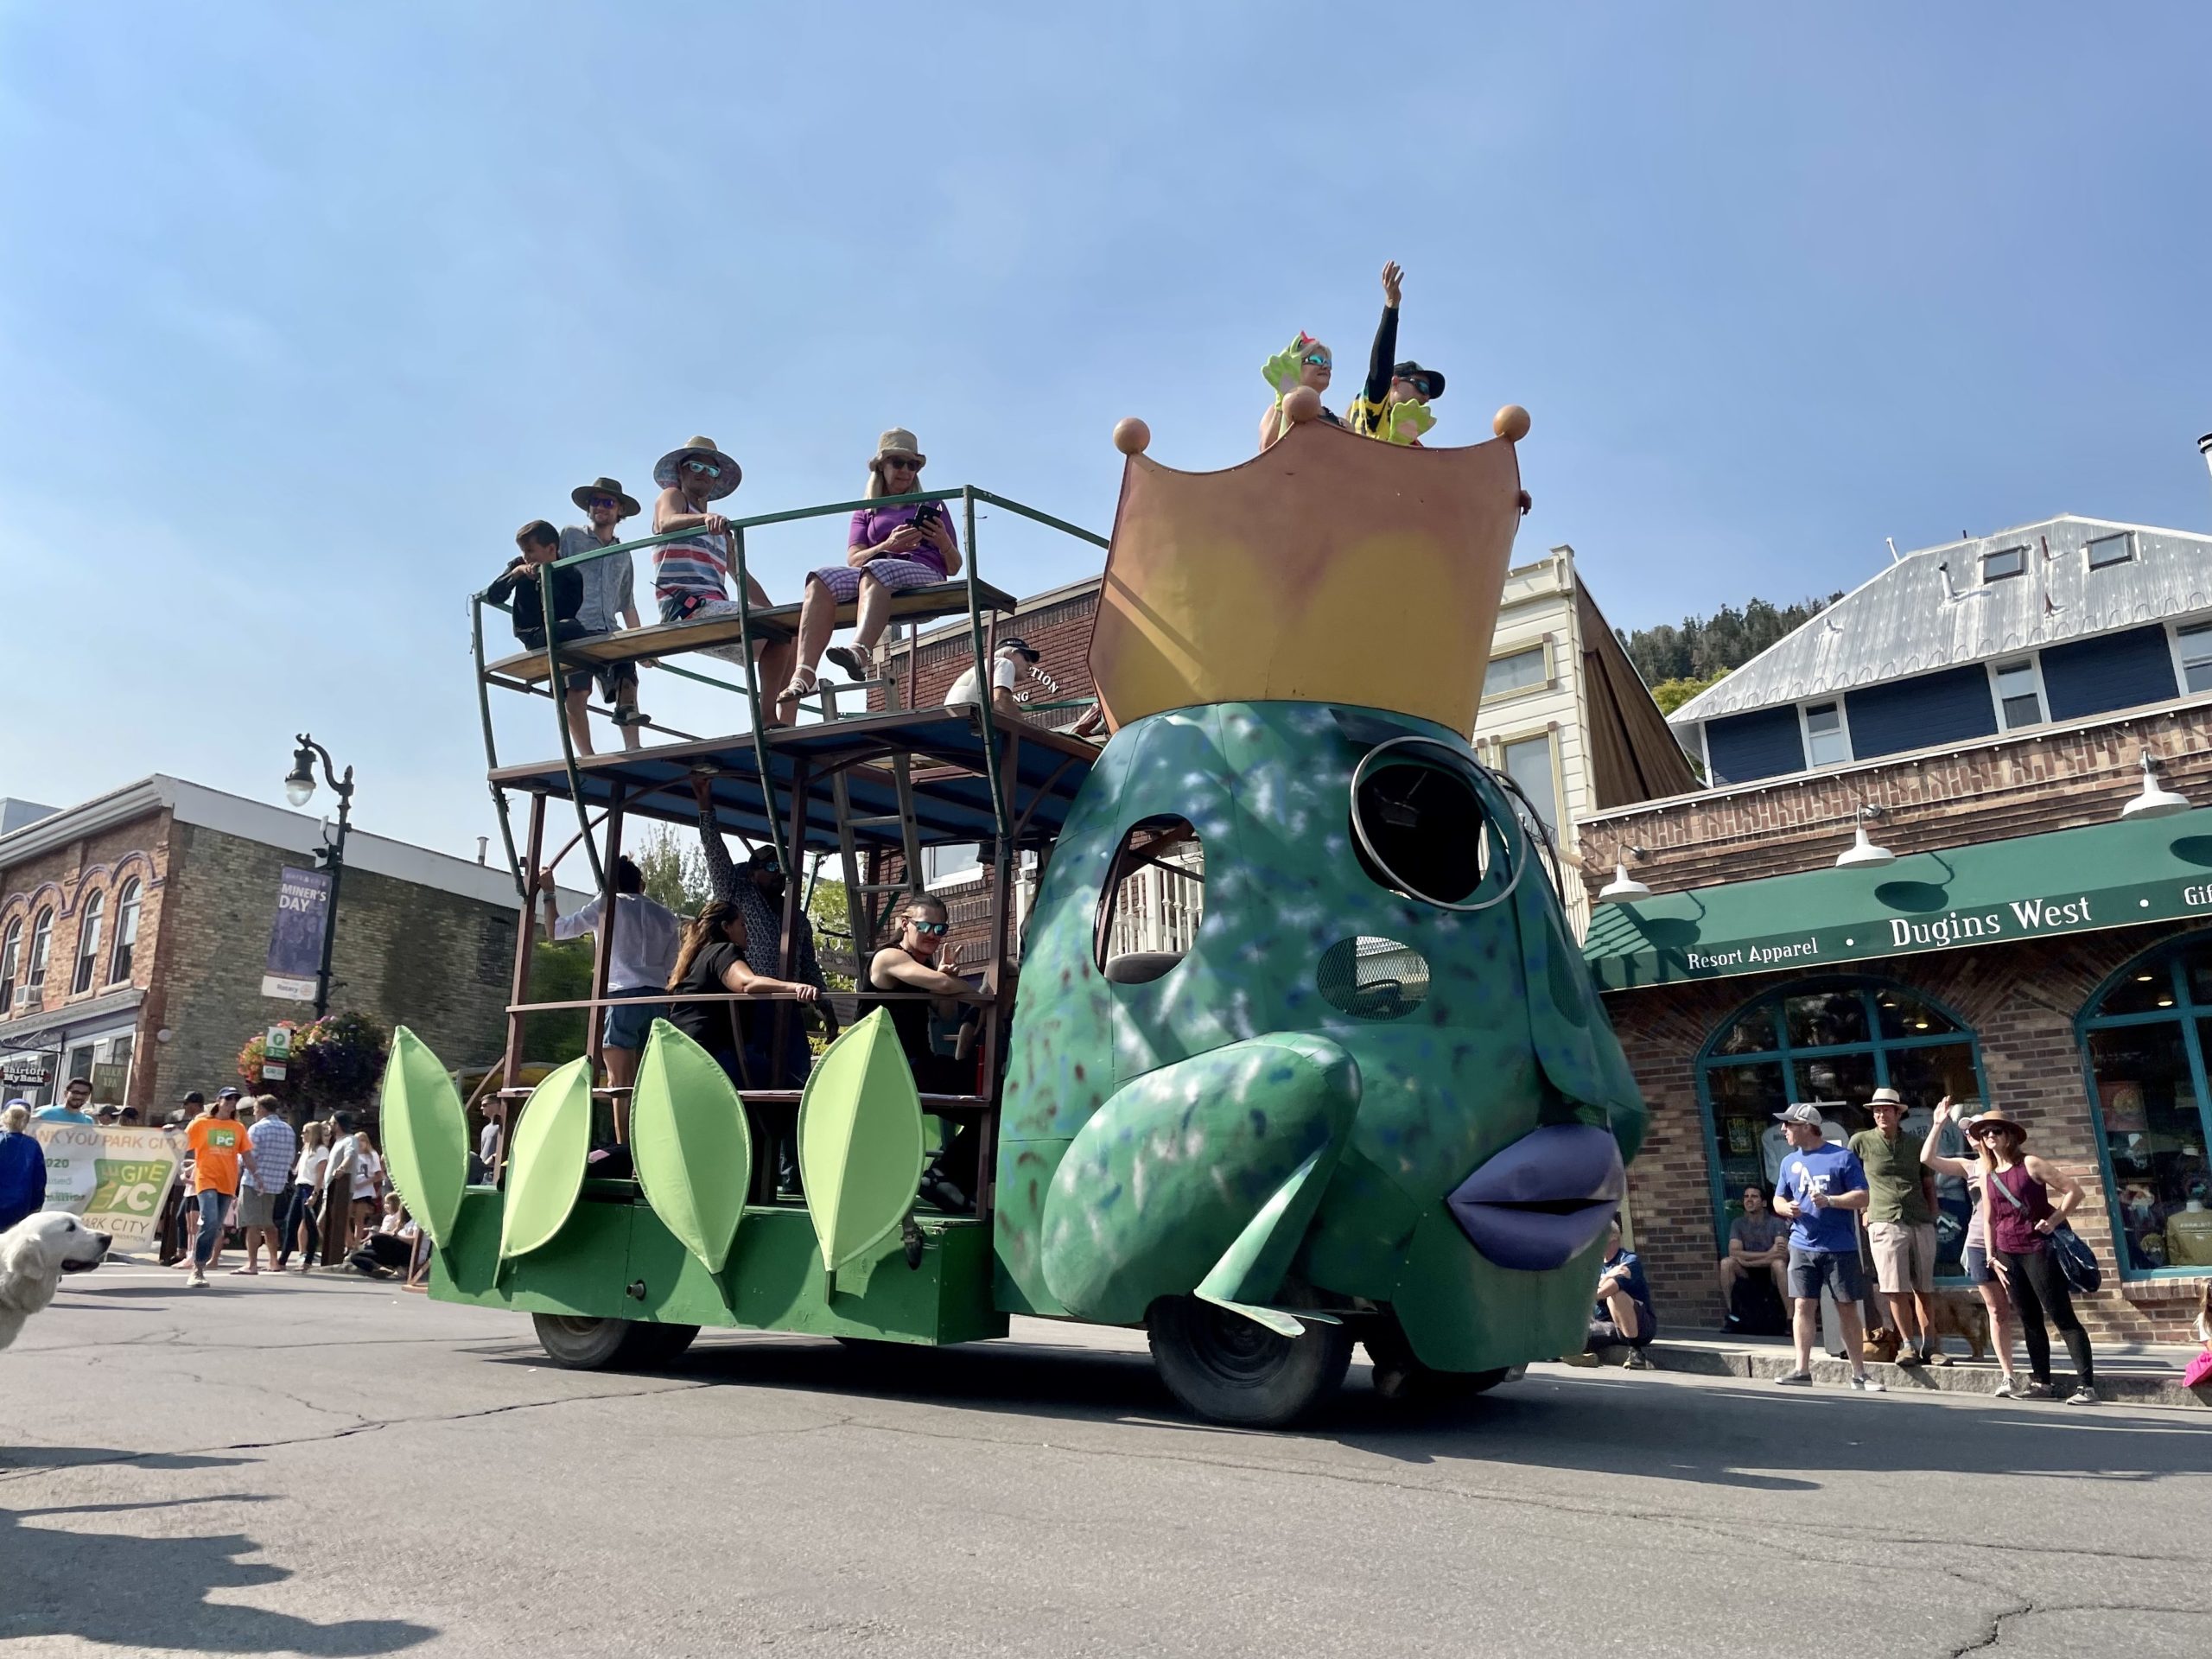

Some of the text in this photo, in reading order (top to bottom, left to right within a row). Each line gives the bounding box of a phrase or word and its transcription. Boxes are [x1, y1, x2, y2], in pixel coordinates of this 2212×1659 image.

[1029, 667, 1059, 694] TION
[281, 883, 327, 901] MINER'S
[279, 894, 310, 912] DAY
[1889, 897, 2092, 947] Dugins West
[1688, 938, 1819, 969] Resort Apparel
[67, 1132, 99, 1146] YOU
[103, 1135, 143, 1148] PARK
[216, 1135, 234, 1147] PC
[46, 1158, 70, 1167] 020
[121, 1165, 166, 1183] GIE
[1798, 1166, 1831, 1192] AF
[81, 1217, 150, 1234] ARK CITY
